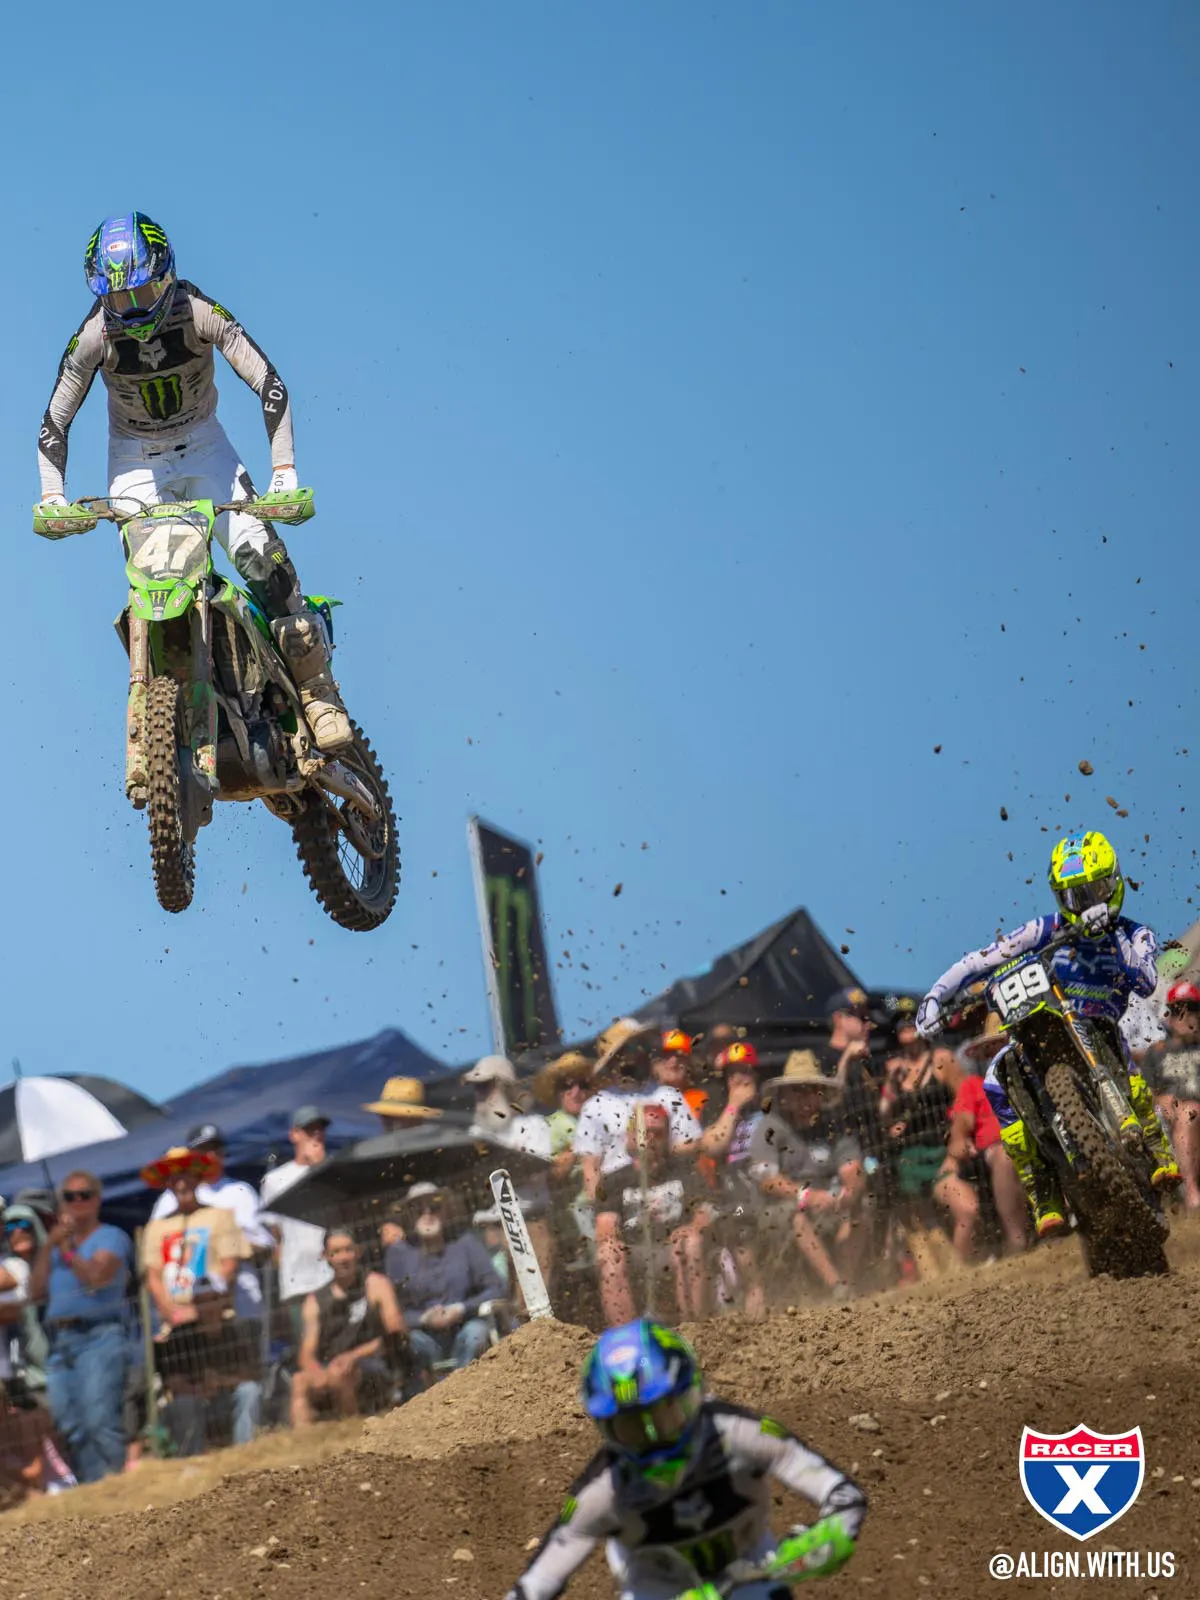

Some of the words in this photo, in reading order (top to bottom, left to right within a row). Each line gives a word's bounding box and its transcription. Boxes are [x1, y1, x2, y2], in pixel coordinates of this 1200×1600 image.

[264, 377, 284, 413] FOX
[40, 418, 60, 448] OX
[274, 473, 285, 494] FOX
[132, 524, 207, 573] 47
[990, 962, 1050, 1019] 199
[501, 1206, 525, 1254] UFO
